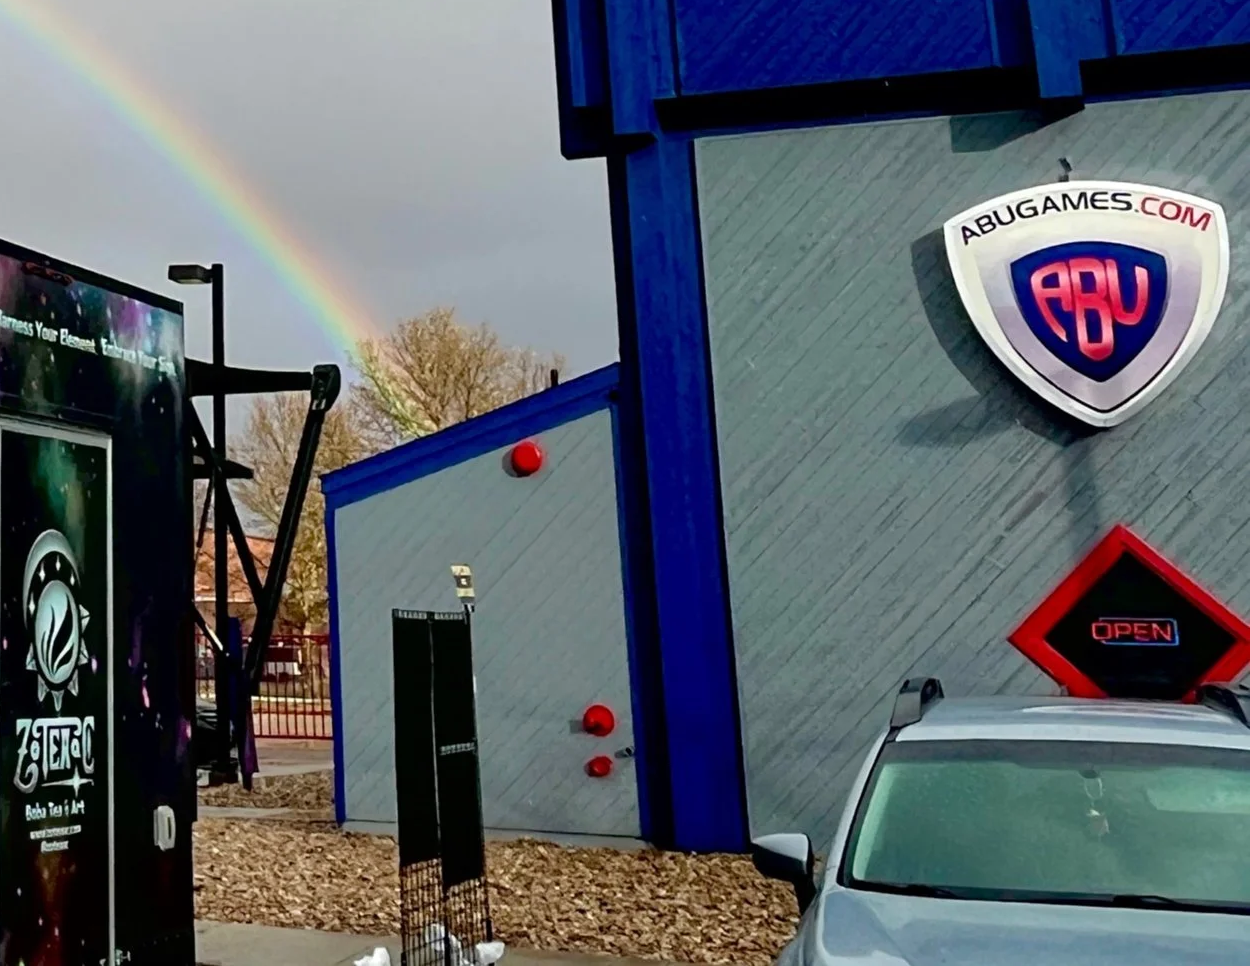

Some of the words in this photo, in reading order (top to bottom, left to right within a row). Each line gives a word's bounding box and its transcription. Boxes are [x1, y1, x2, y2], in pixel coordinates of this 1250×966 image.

[960, 191, 1212, 246] ABUGAMES.COM
[1030, 257, 1149, 362] ABU
[1091, 622, 1172, 641] OPEN
